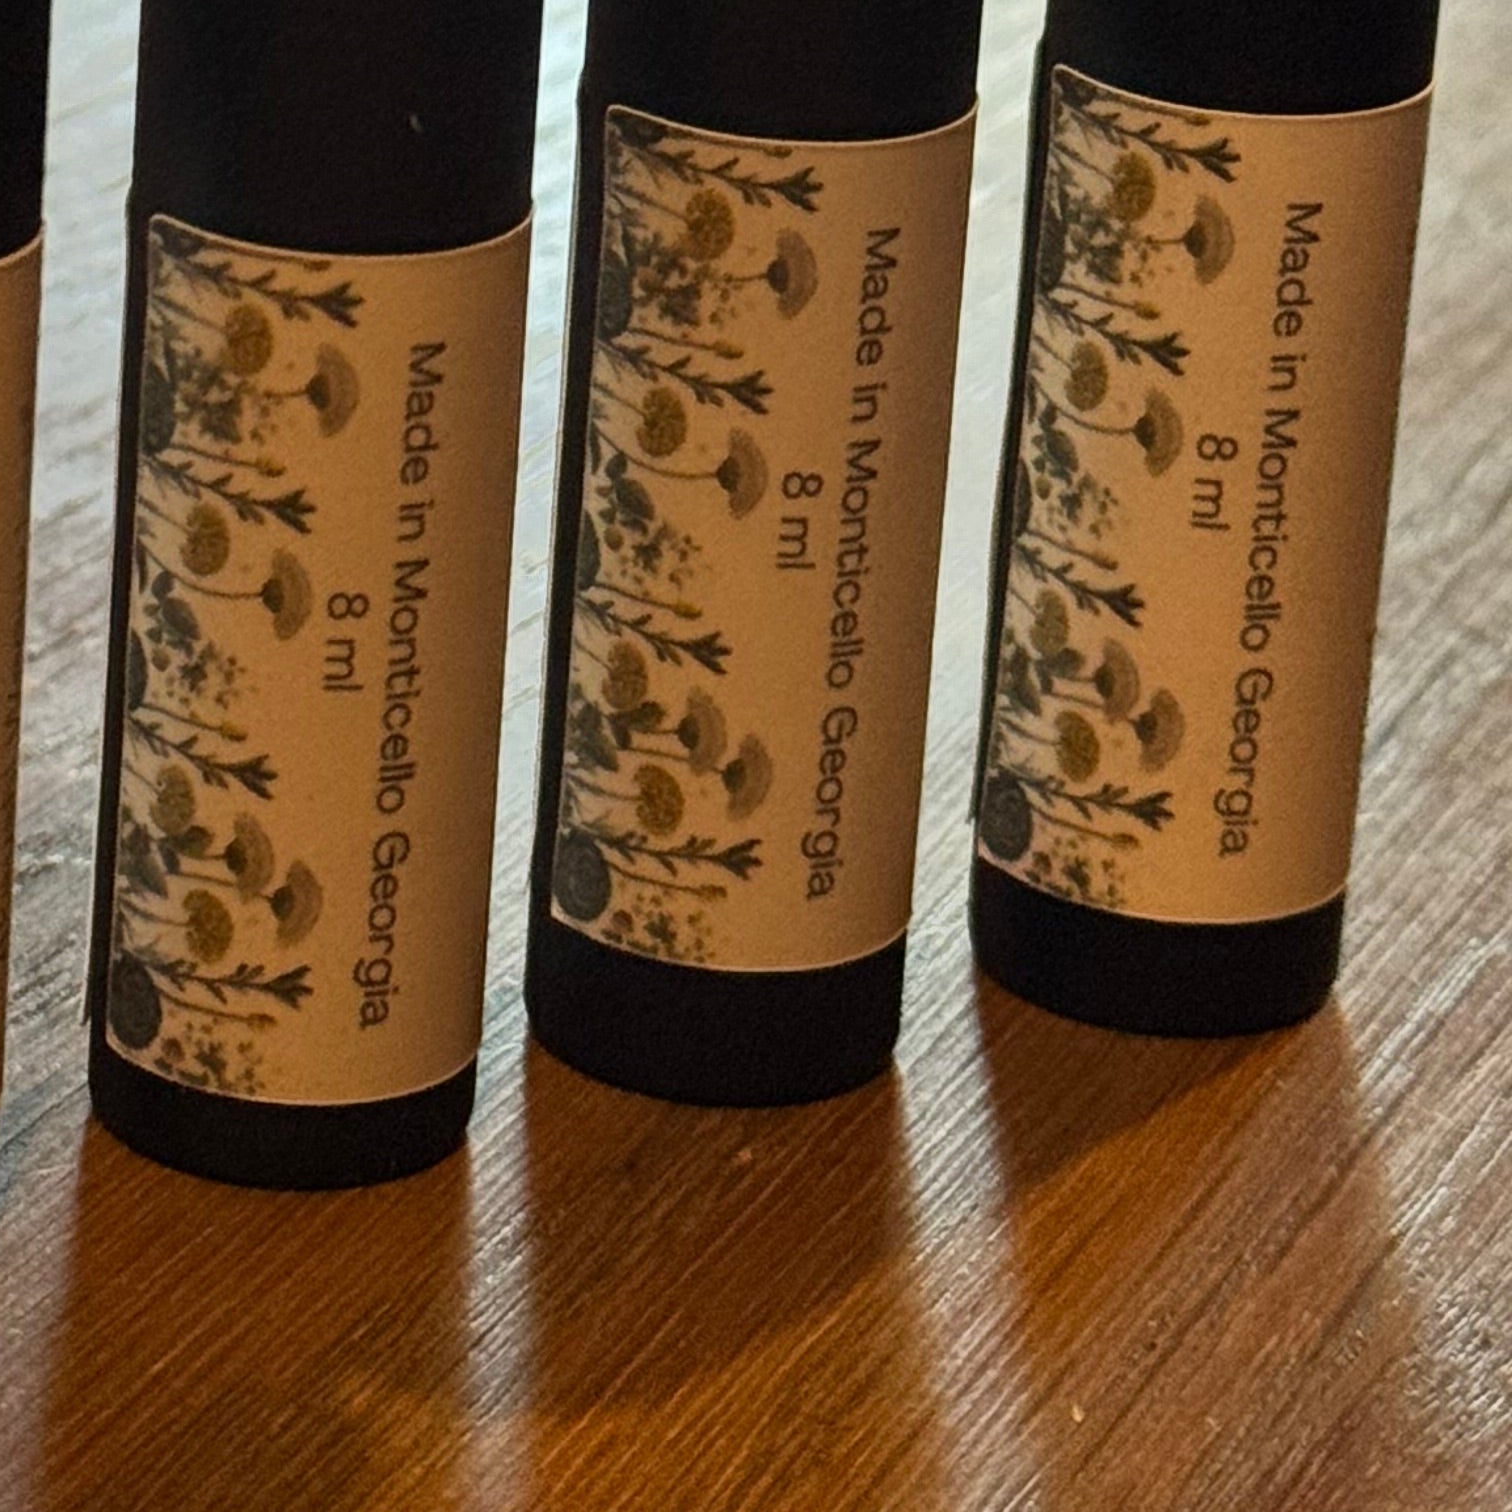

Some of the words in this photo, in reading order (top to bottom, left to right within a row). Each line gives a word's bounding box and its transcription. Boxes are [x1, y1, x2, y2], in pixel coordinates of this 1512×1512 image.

[854, 227, 901, 365] Made
[1272, 202, 1323, 336] Made
[396, 341, 447, 483] Made
[848, 381, 886, 424] in
[1268, 350, 1307, 390] in
[781, 470, 823, 499] 8
[1197, 434, 1239, 462] 8
[396, 498, 435, 544] in
[776, 518, 816, 572] ml
[1190, 478, 1230, 531] ml
[1237, 408, 1299, 654] Monticello
[327, 592, 370, 621] 8
[826, 437, 881, 690] Monticello
[322, 637, 364, 692] ml
[375, 559, 430, 813] Monticello
[800, 704, 860, 901] Georgia
[1212, 664, 1274, 860] Georgia
[354, 829, 412, 1031] Georgia
